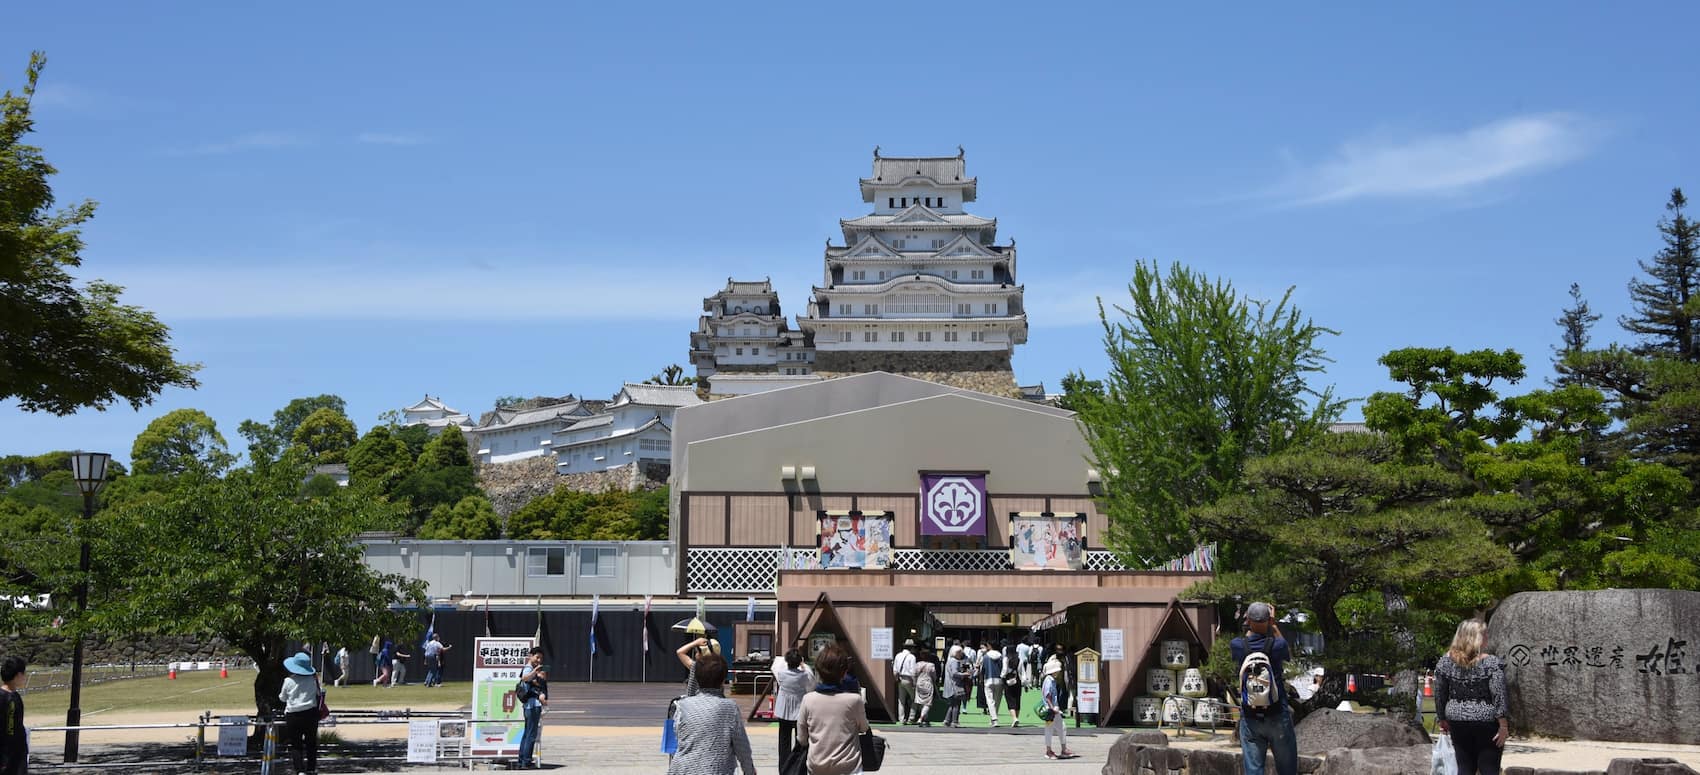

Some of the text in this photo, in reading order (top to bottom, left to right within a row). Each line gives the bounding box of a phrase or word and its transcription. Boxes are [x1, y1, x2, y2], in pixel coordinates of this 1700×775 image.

[480, 647, 530, 657] 平成中村座
[1540, 637, 1700, 676] 世界遺産 姫
